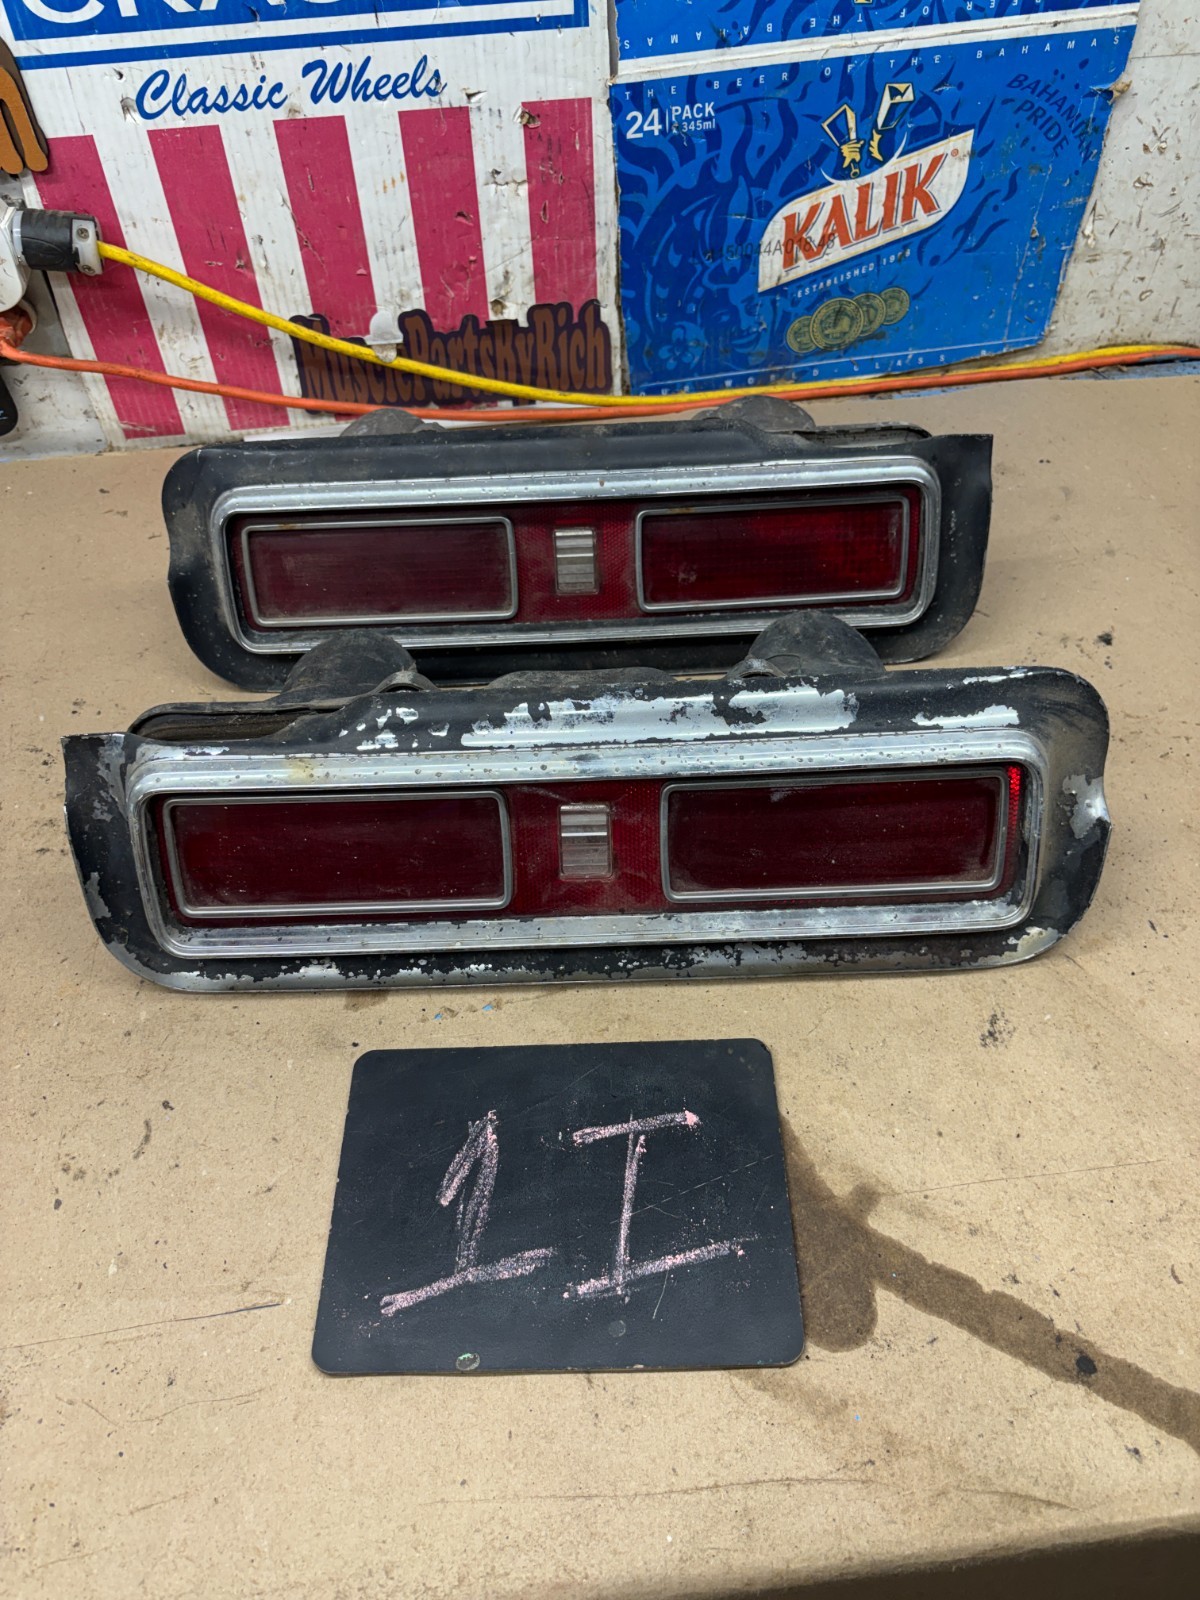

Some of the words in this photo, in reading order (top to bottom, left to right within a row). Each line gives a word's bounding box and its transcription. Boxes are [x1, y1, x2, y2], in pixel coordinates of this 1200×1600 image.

[810, 13, 863, 28] THE
[900, 6, 930, 18] OF
[966, 0, 1041, 10] EER
[624, 23, 773, 49] BAHAMAS
[625, 85, 677, 100] THE
[713, 72, 788, 89] BEER
[824, 64, 854, 76] OF
[889, 55, 941, 69] THE
[976, 35, 1120, 59] BAHAMAS
[135, 69, 288, 120] Classic
[302, 54, 447, 105] Wheels
[625, 108, 662, 140] 24
[672, 101, 715, 121] PACK
[681, 118, 716, 133] 345ml
[1013, 99, 1069, 158] PRIDE
[782, 153, 948, 272] KALIK
[797, 263, 875, 298] ESTABLISHED
